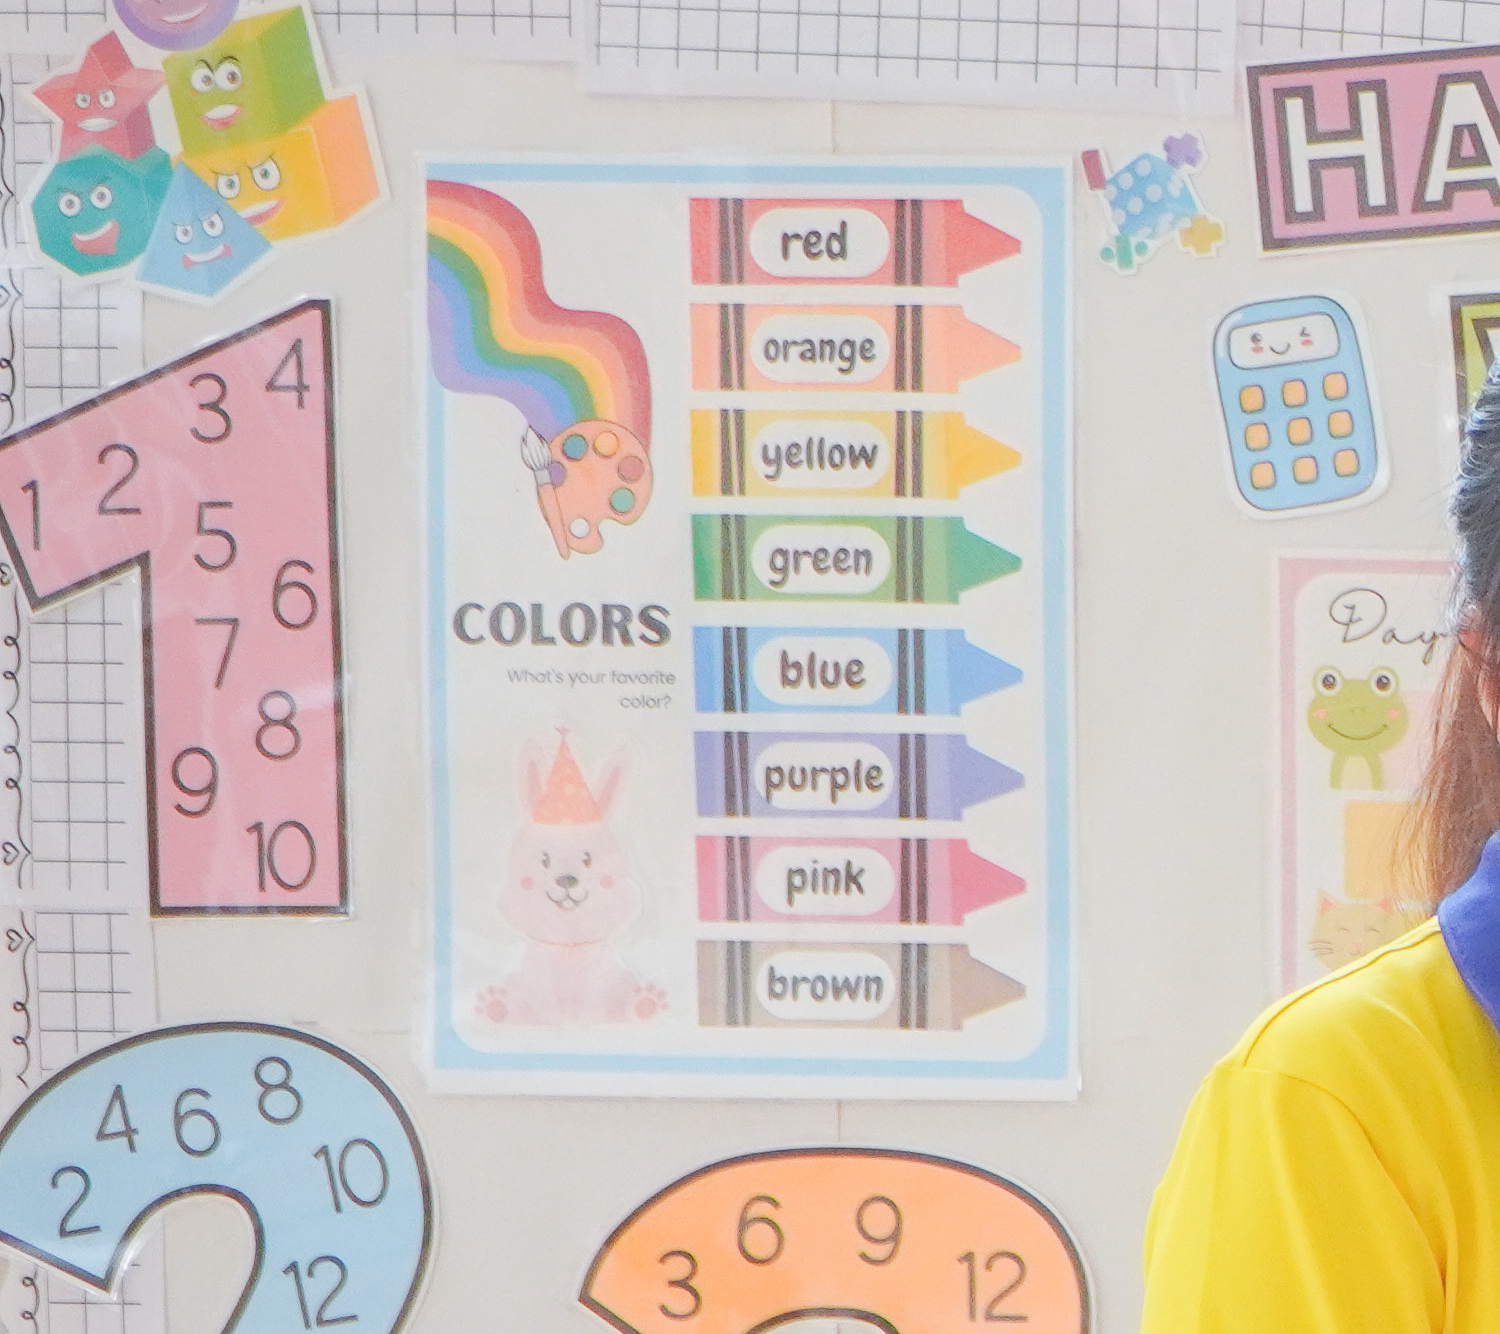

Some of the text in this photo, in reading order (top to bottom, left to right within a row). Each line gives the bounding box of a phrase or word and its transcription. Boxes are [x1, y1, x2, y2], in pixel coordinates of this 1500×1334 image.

[781, 219, 848, 261] red
[264, 337, 311, 410] 4
[763, 337, 876, 375] orange
[188, 372, 233, 444] 3
[97, 442, 142, 516] 2
[761, 436, 879, 481] yellow
[20, 479, 40, 551] 1
[193, 500, 237, 573] 5
[271, 559, 318, 631] 6
[768, 546, 873, 589] green
[194, 617, 241, 690] 7
[452, 601, 671, 647] COLORS
[506, 669, 676, 688] What's your favorite
[619, 695, 672, 709] color?
[779, 649, 866, 689] blue
[254, 689, 301, 762] 8
[170, 746, 219, 819] 9
[764, 758, 884, 806] purple
[245, 819, 317, 893] 10
[786, 859, 865, 907] pink
[767, 965, 884, 1003] brown
[95, 1083, 139, 1154] 4
[173, 1087, 222, 1158] 6
[253, 1055, 303, 1125] 8
[50, 1165, 101, 1239] 2
[312, 1137, 390, 1214] 10
[736, 1194, 785, 1267] 6
[855, 1195, 903, 1267] 9
[281, 1254, 359, 1330] 12
[658, 1249, 702, 1320] 3
[956, 1250, 1029, 1323] 12
